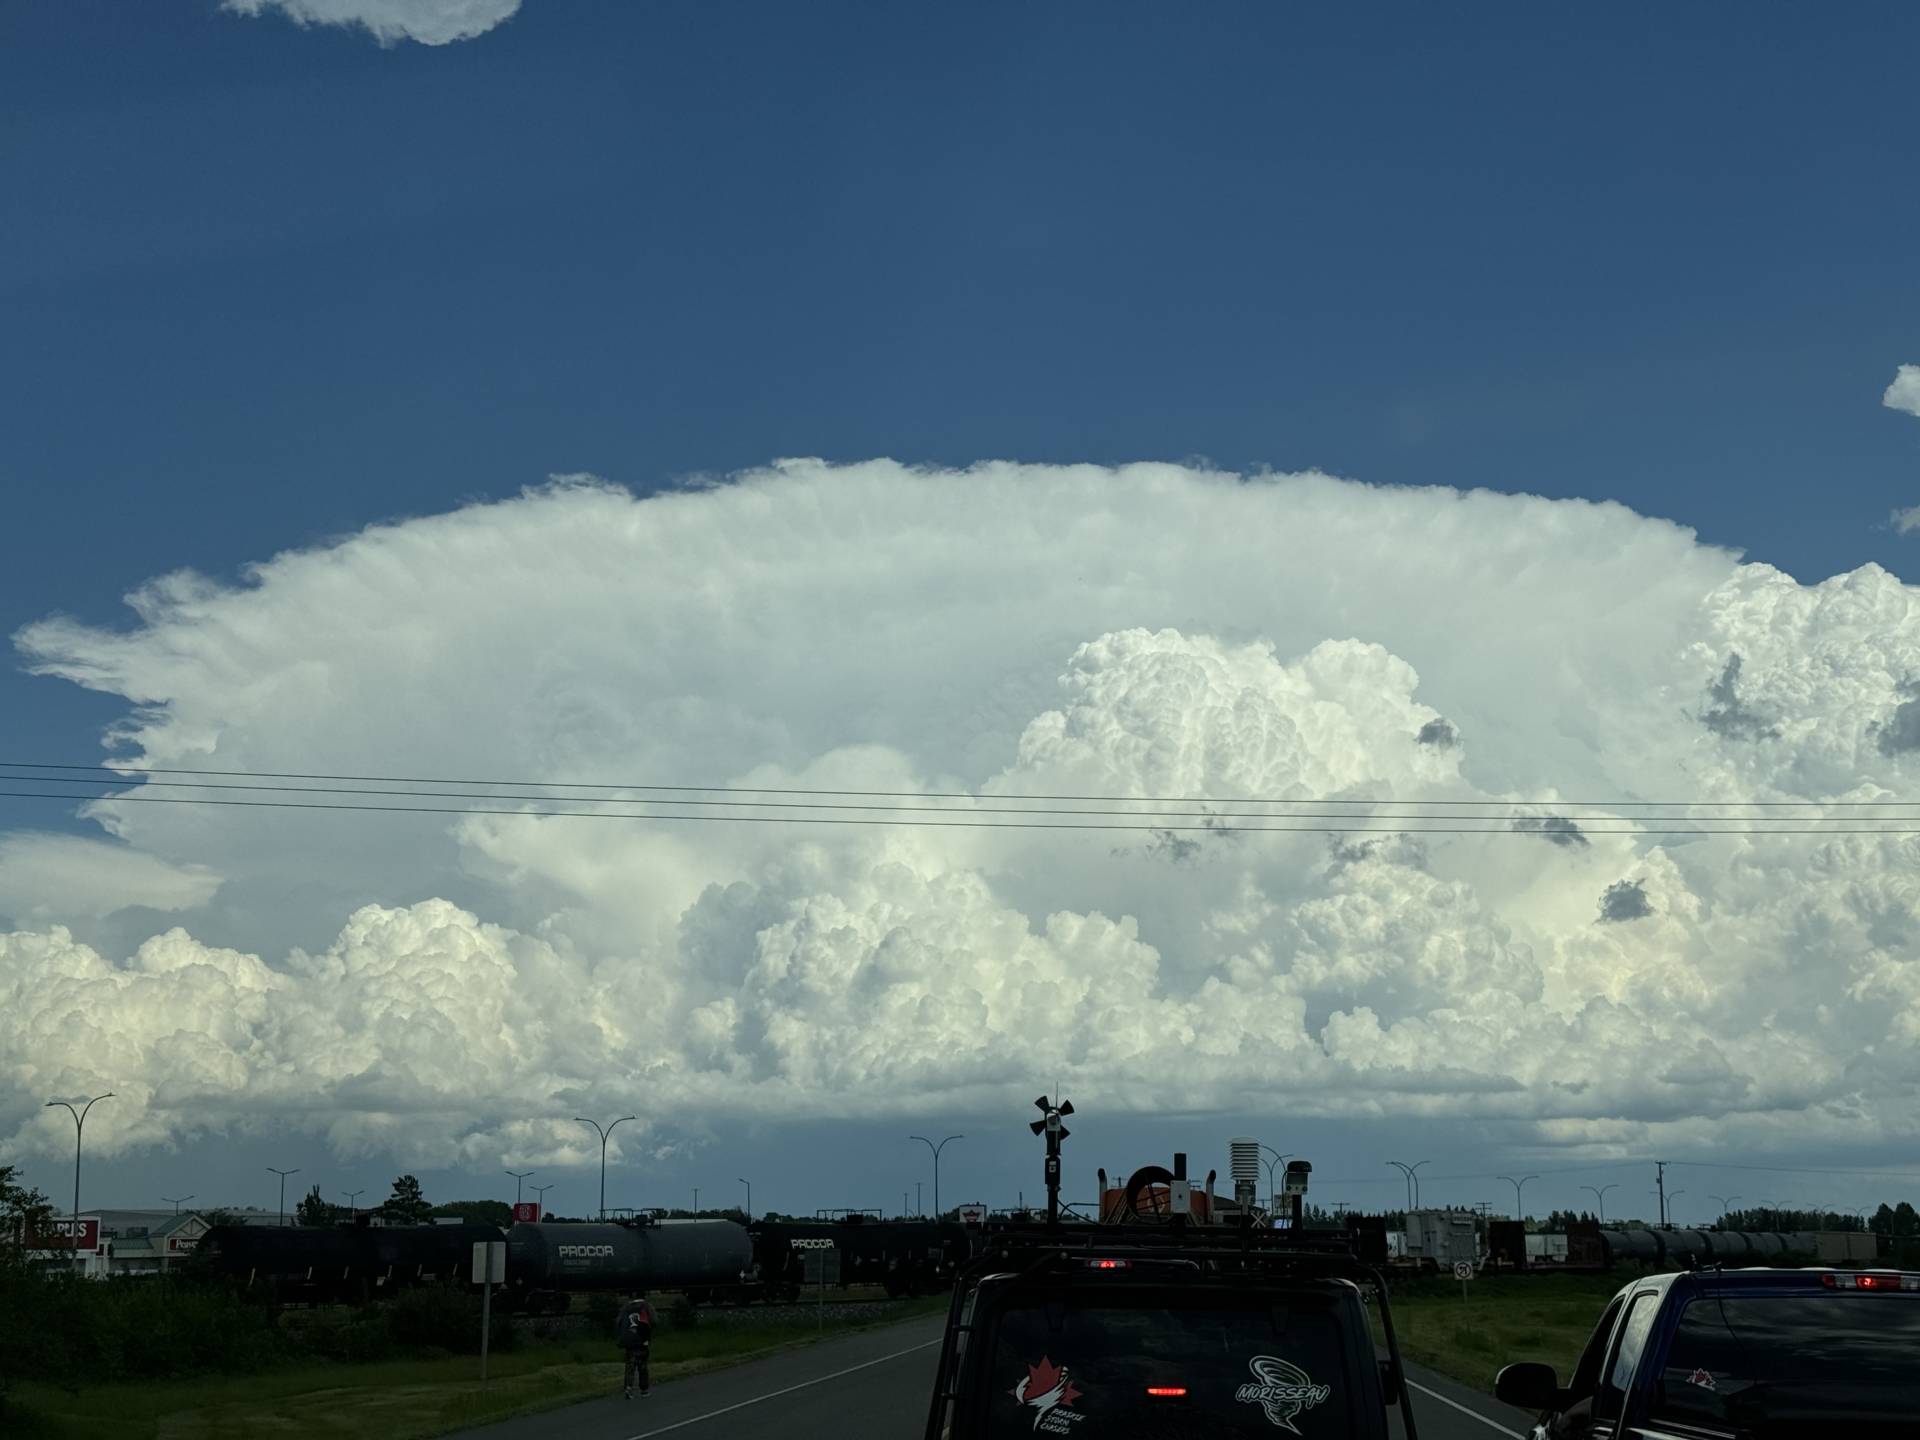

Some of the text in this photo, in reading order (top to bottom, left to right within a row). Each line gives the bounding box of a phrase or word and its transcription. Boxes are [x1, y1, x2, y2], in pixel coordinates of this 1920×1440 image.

[790, 1238, 835, 1249] PROCOR
[558, 1245, 614, 1257] PROCOR
[1237, 1385, 1330, 1406] MORISSEAU
[1045, 1415, 1070, 1427] STORM
[1040, 1422, 1071, 1436] CHASERS
